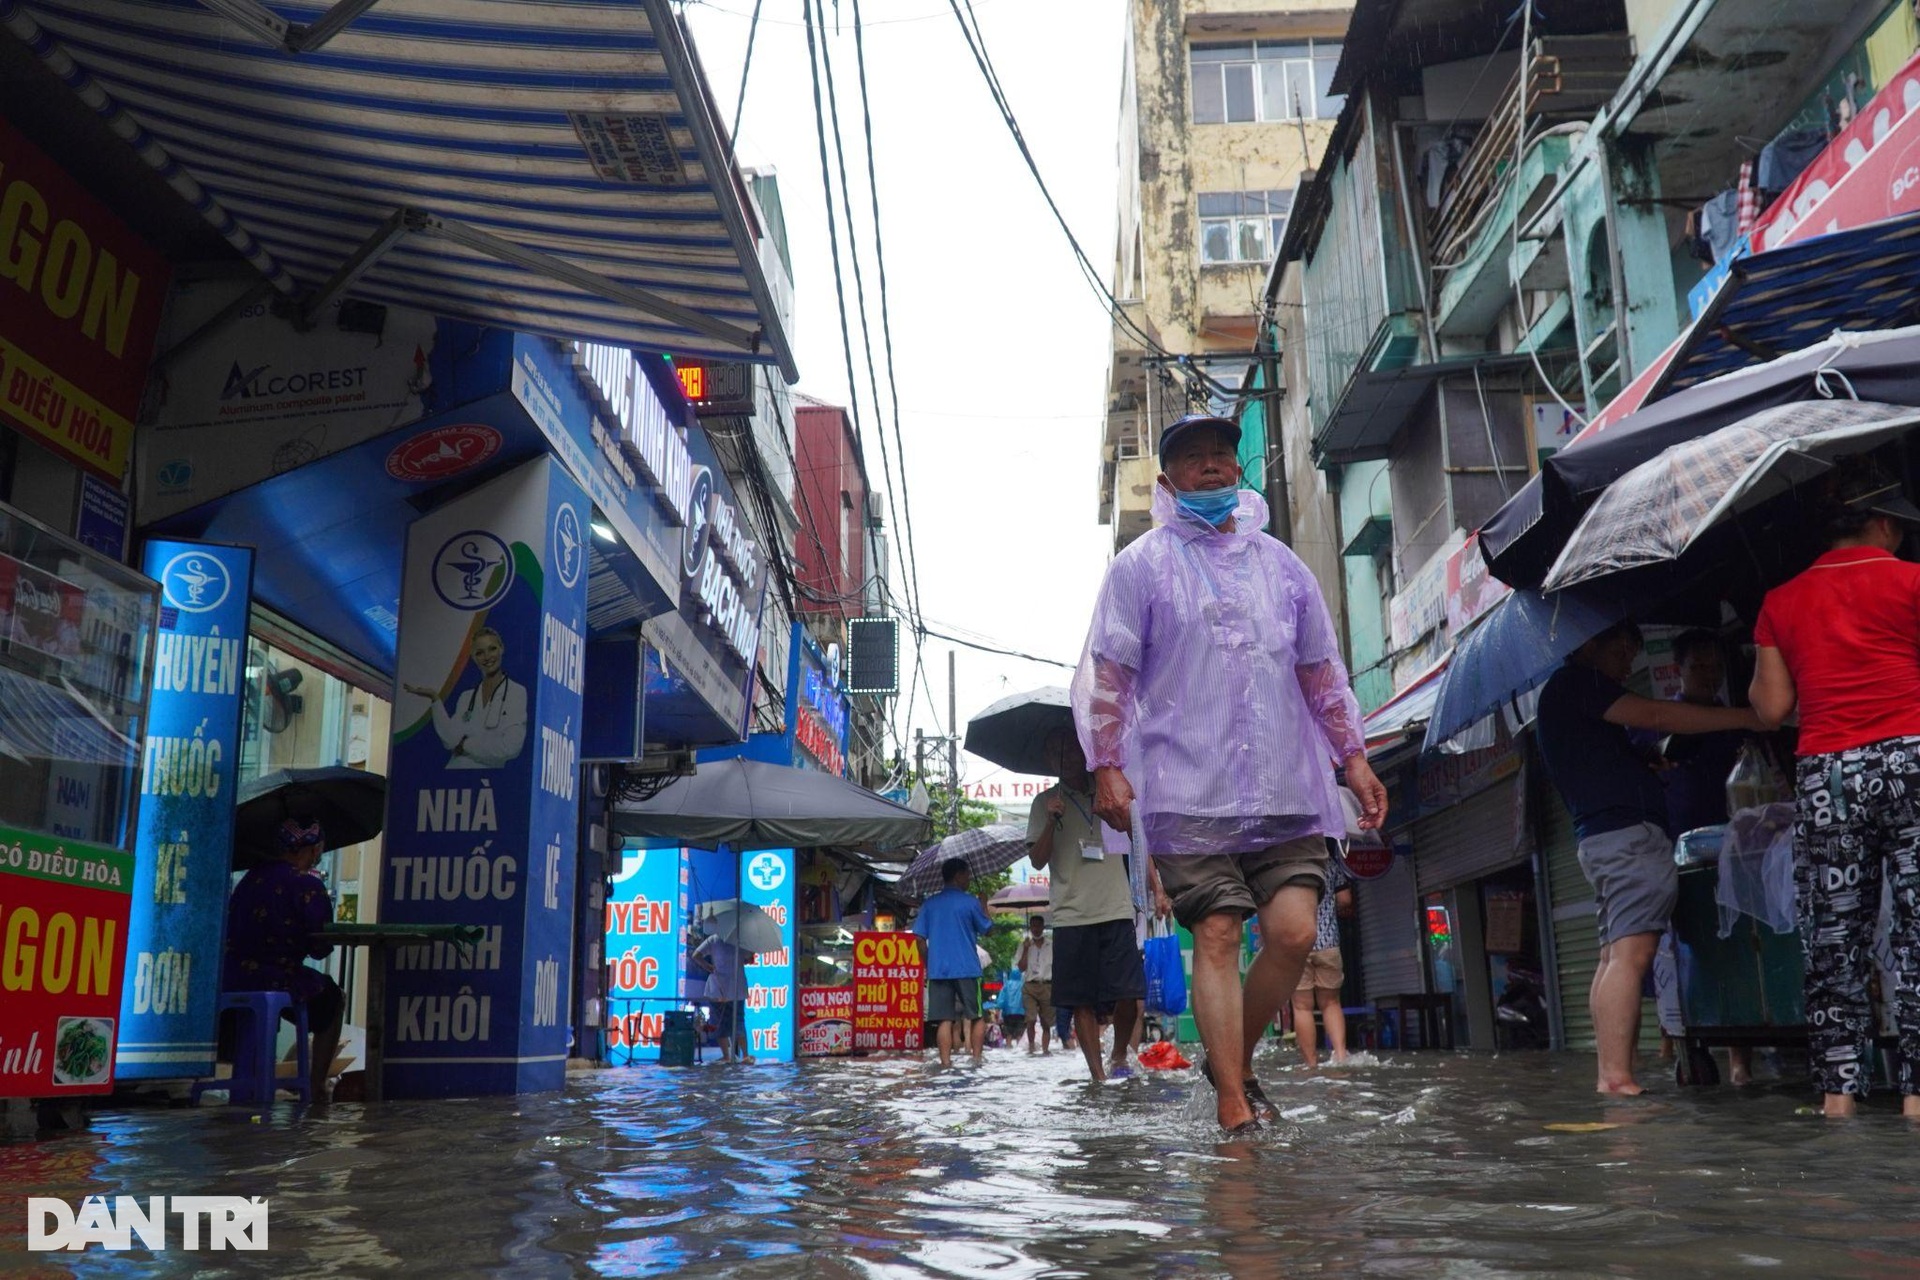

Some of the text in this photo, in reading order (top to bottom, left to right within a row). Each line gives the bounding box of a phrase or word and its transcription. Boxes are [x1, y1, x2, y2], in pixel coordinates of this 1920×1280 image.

[0, 162, 140, 359] GON
[8, 368, 68, 440] ĐIỀU
[67, 406, 114, 462] HÒA
[631, 358, 667, 487] MINH
[713, 494, 758, 590] NHÀ THUỐC
[700, 545, 740, 639] BẠCH
[731, 607, 760, 672] MAI
[541, 610, 584, 698] CHUYÊN
[540, 715, 575, 802] THUỐC
[416, 778, 498, 833] NHÀ
[27, 846, 79, 878] ĐIỀU
[81, 858, 122, 887] HÒA
[154, 830, 190, 904] KÊ
[391, 838, 517, 901] THUỐC
[544, 833, 561, 911] KÊ
[0, 904, 117, 996] GON
[133, 946, 191, 1015] ĐƠN
[856, 934, 921, 966] CƠM
[857, 965, 920, 981] HẢI HẬU
[397, 983, 492, 1043] KHÔI
[533, 956, 559, 1028] ĐƠN
[801, 989, 826, 1007] CƠM
[836, 1006, 852, 1020] HẬ
[856, 1013, 920, 1029] MIẾN NGAN
[857, 979, 919, 1003] PHỞ BÒ
[900, 996, 919, 1013] GÀ
[0, 1031, 43, 1075] nh
[752, 1021, 780, 1051] Y TẾ
[855, 1031, 877, 1048] BÚN
[879, 1030, 895, 1048] CÁ
[904, 1028, 920, 1048] ỐC
